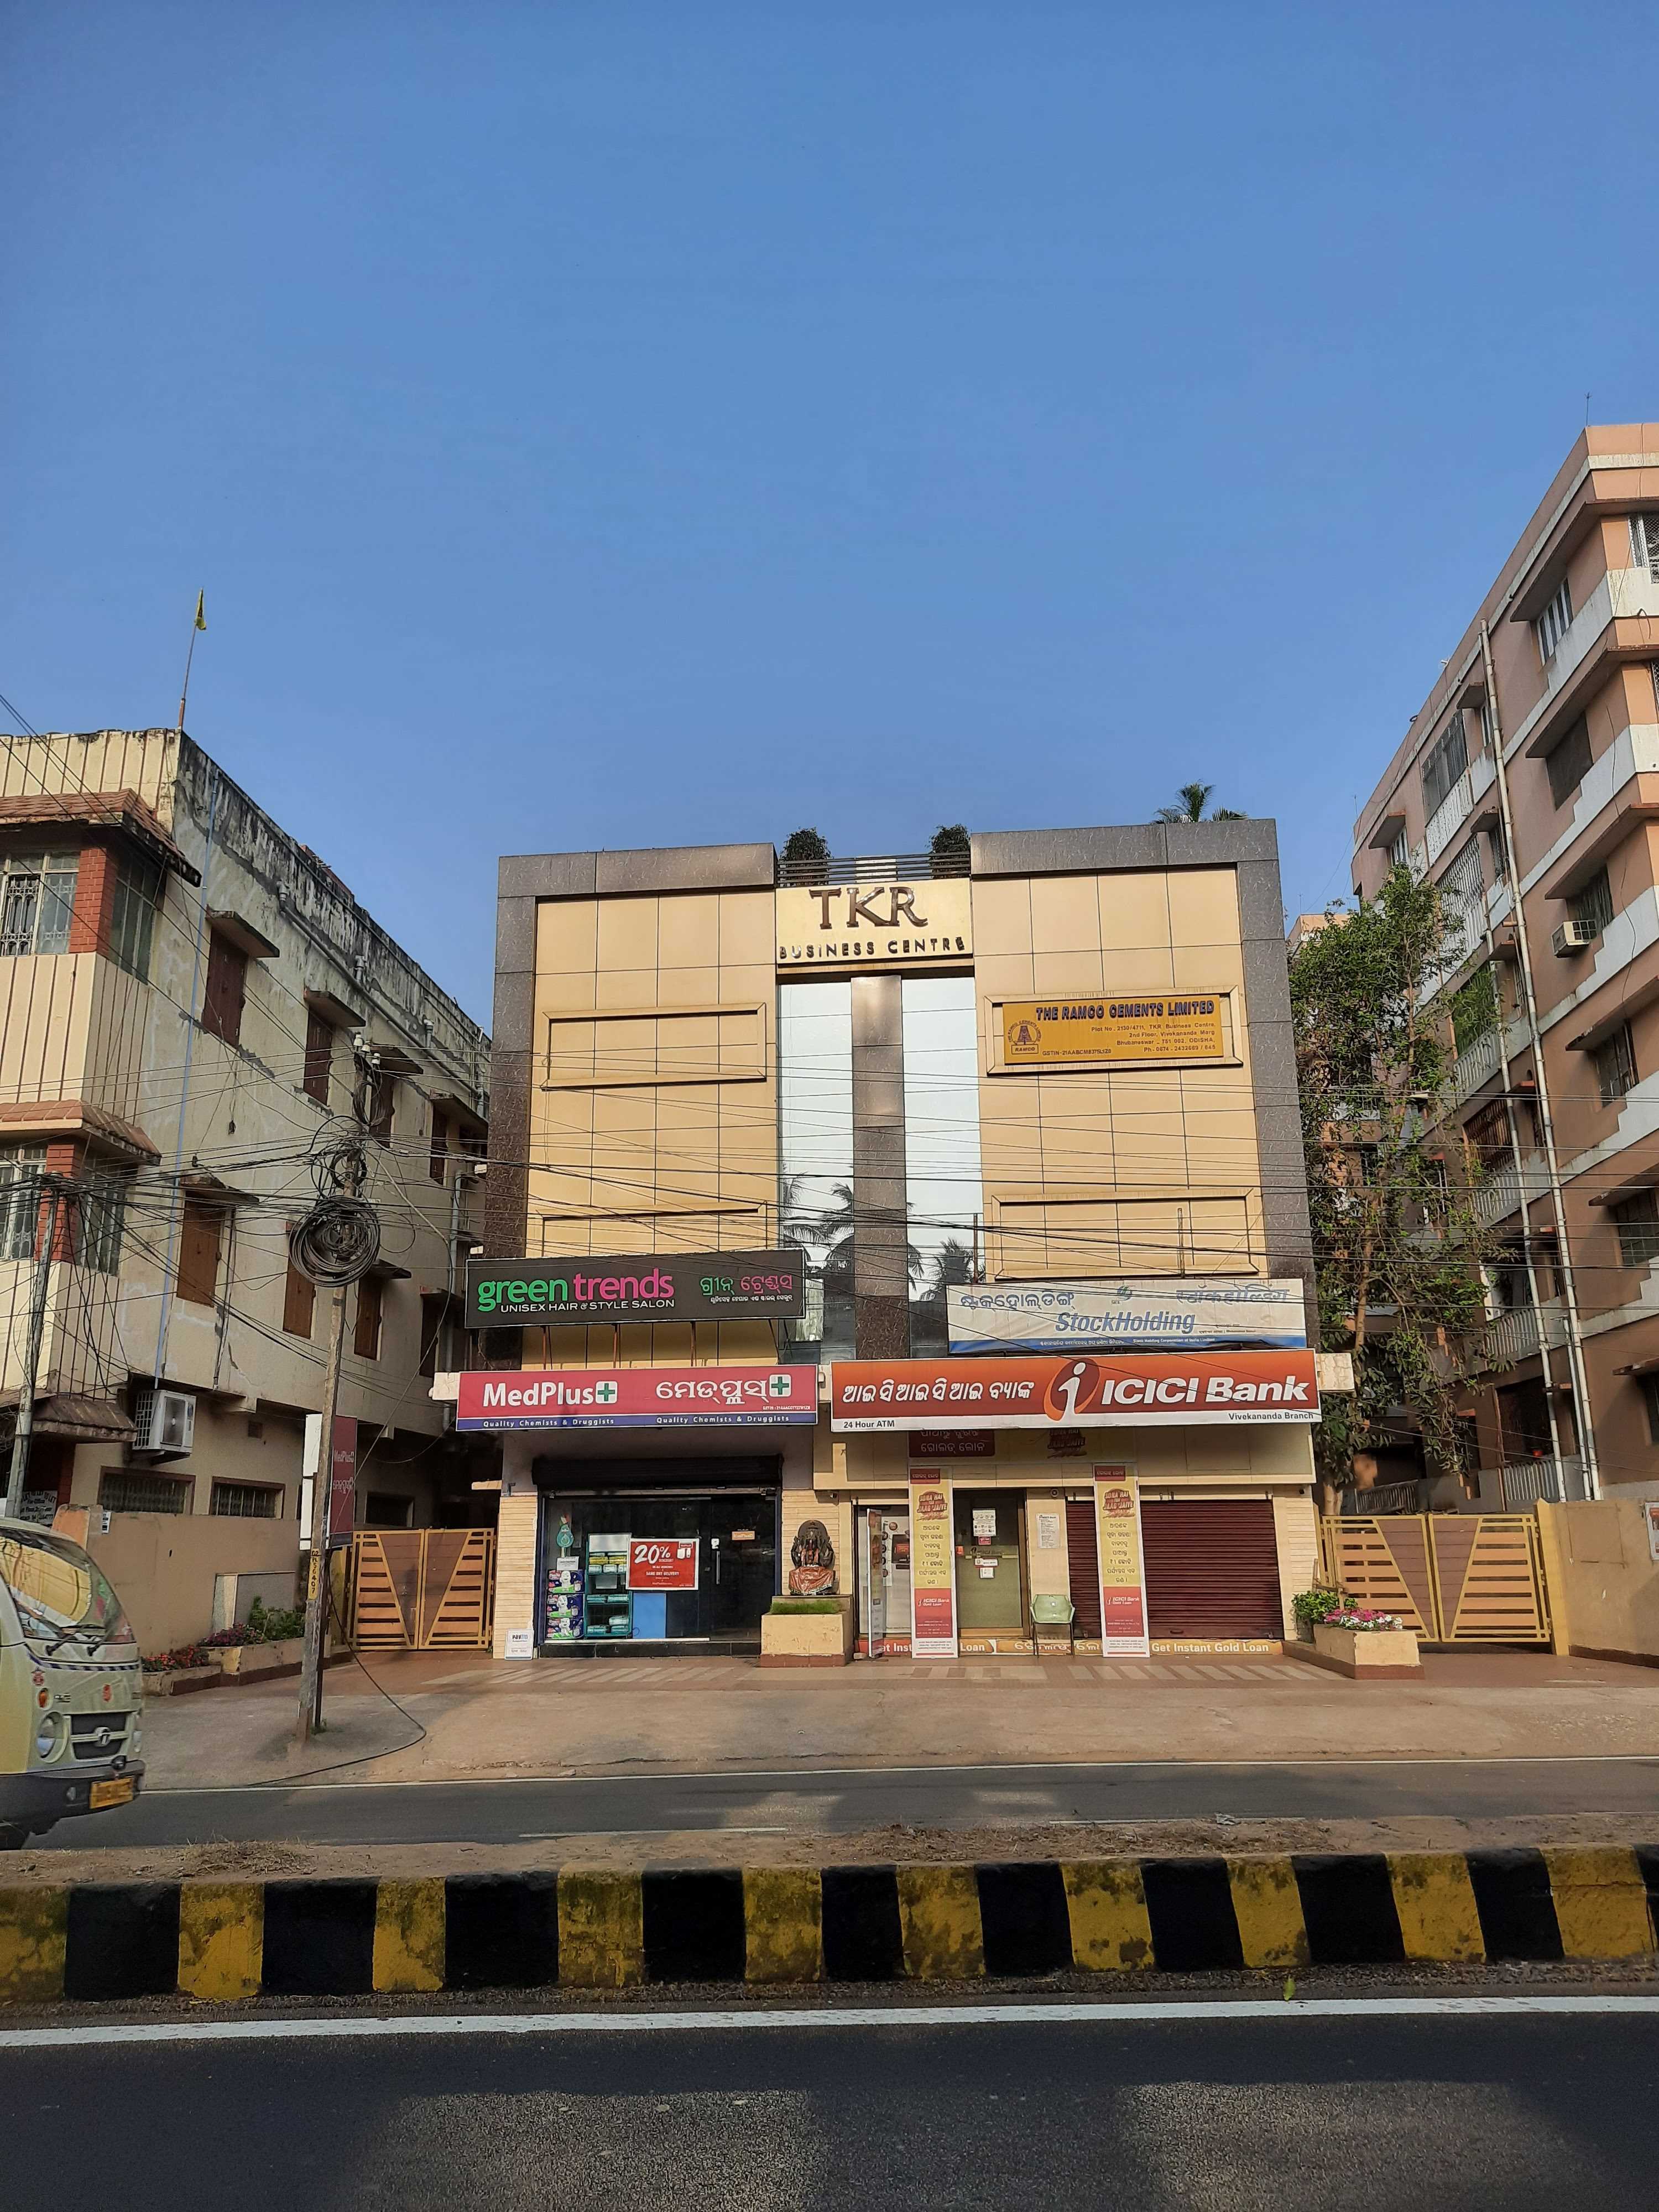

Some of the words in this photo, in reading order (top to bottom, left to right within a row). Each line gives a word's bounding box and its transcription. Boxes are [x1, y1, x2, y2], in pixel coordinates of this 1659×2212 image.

[809, 886, 927, 930] TKR
[779, 941, 875, 959] BUSINESS
[888, 936, 964, 953] CENTRE
[1036, 1006, 1058, 1021] THE
[1061, 1005, 1104, 1020] RAMCO
[1109, 1003, 1164, 1019] CEMENTS
[1167, 1000, 1215, 1016] LIMITED
[477, 1278, 567, 1312] green
[573, 1267, 674, 1301] trends
[500, 1303, 546, 1313] UNISEX
[549, 1302, 578, 1311] HAIR
[589, 1301, 629, 1310] STYLE
[630, 1300, 674, 1308] SALON
[1055, 1311, 1196, 1334] StockHolding
[483, 1381, 593, 1407] MedPlus
[1102, 1377, 1199, 1405] ICICI
[1206, 1375, 1310, 1402] Bank
[483, 1420, 515, 1428] Quality
[572, 1417, 614, 1426] Druggists
[877, 1420, 895, 1428] ATM
[1229, 1412, 1282, 1421] Vivekananda
[1285, 1411, 1313, 1420] Branch
[634, 1545, 671, 1564] 20%
[960, 1642, 985, 1652] Loan
[1151, 1642, 1170, 1652] Get
[1174, 1642, 1212, 1652] Instant
[1214, 1642, 1239, 1652] Gold
[1243, 1642, 1269, 1652] Loan
